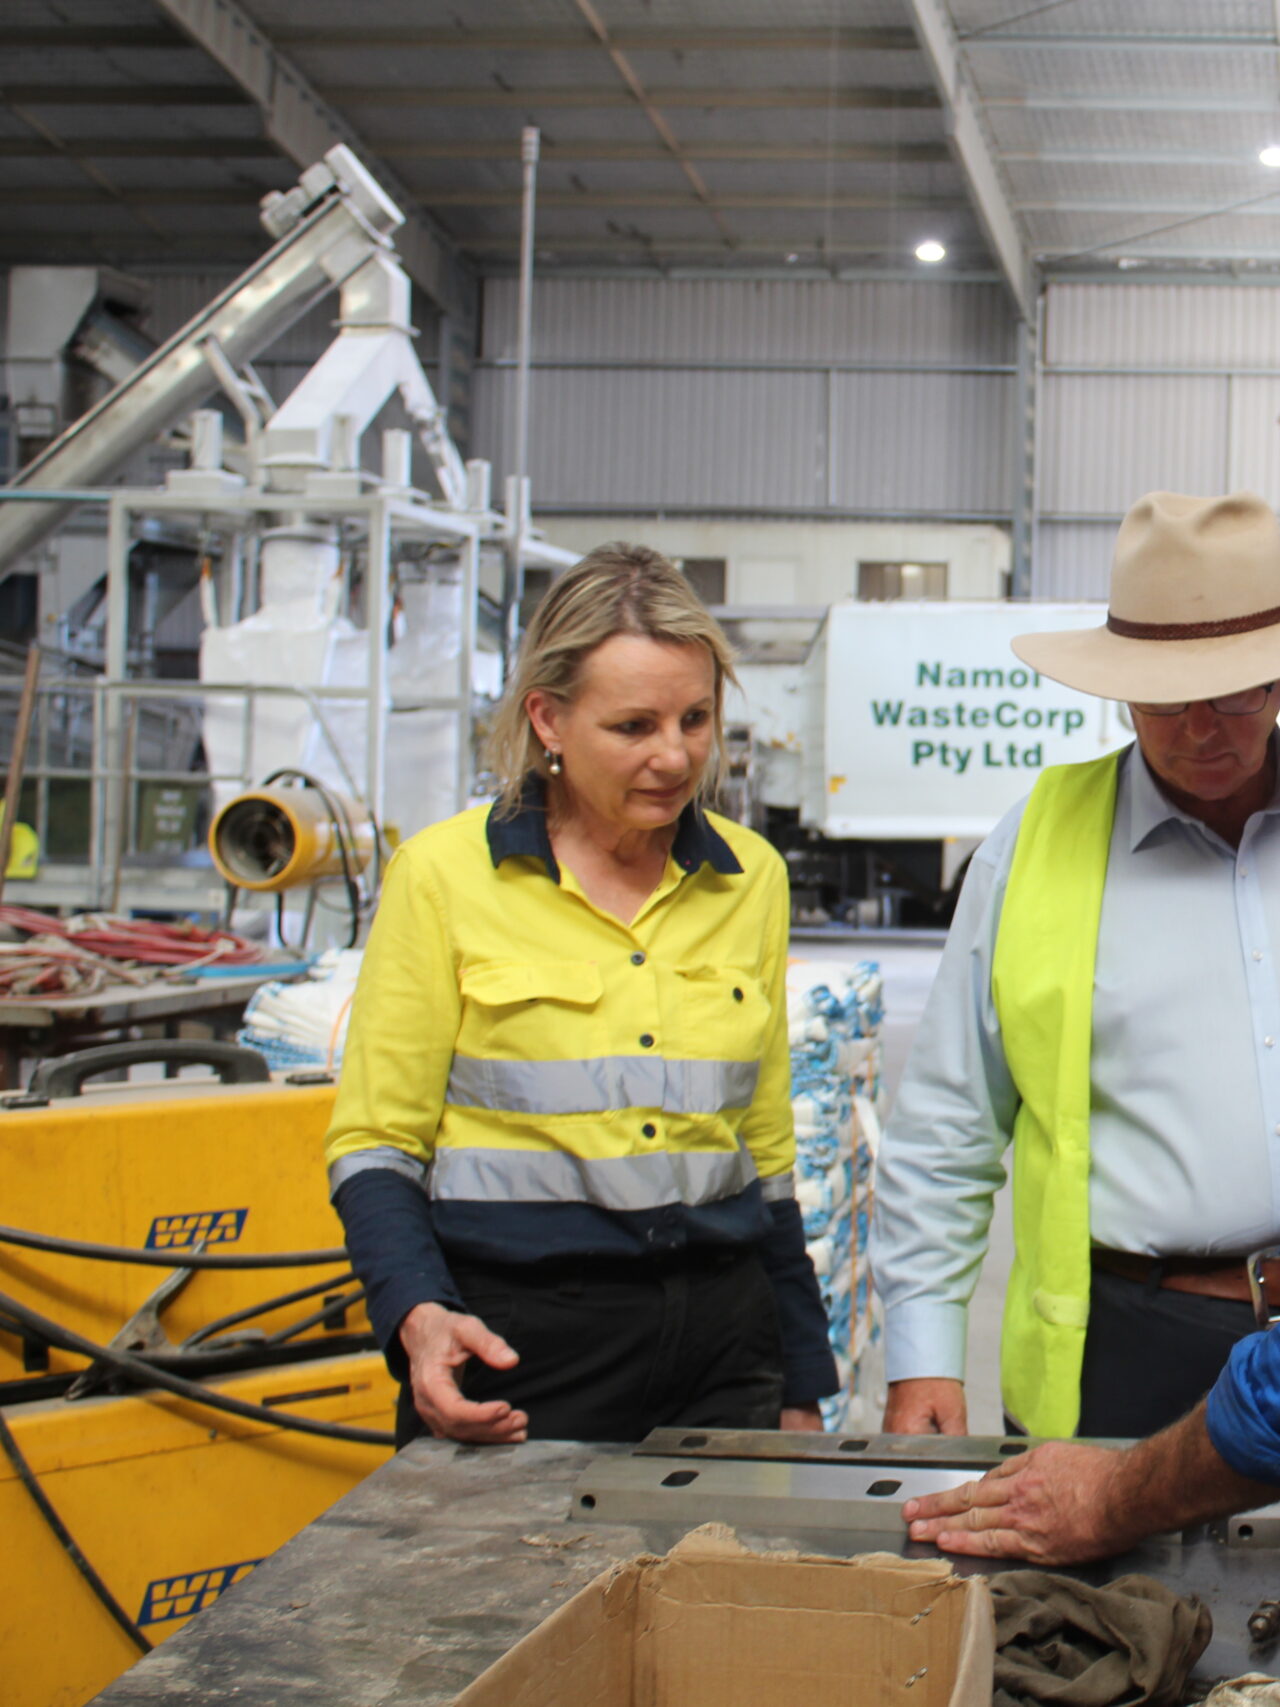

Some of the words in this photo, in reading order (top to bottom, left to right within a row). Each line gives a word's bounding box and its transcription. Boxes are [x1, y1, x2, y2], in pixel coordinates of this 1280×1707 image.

[871, 700, 1085, 736] WasteCorp
[912, 741, 972, 774] Pty
[984, 741, 1043, 767] Ltd
[152, 1210, 240, 1248] WIA
